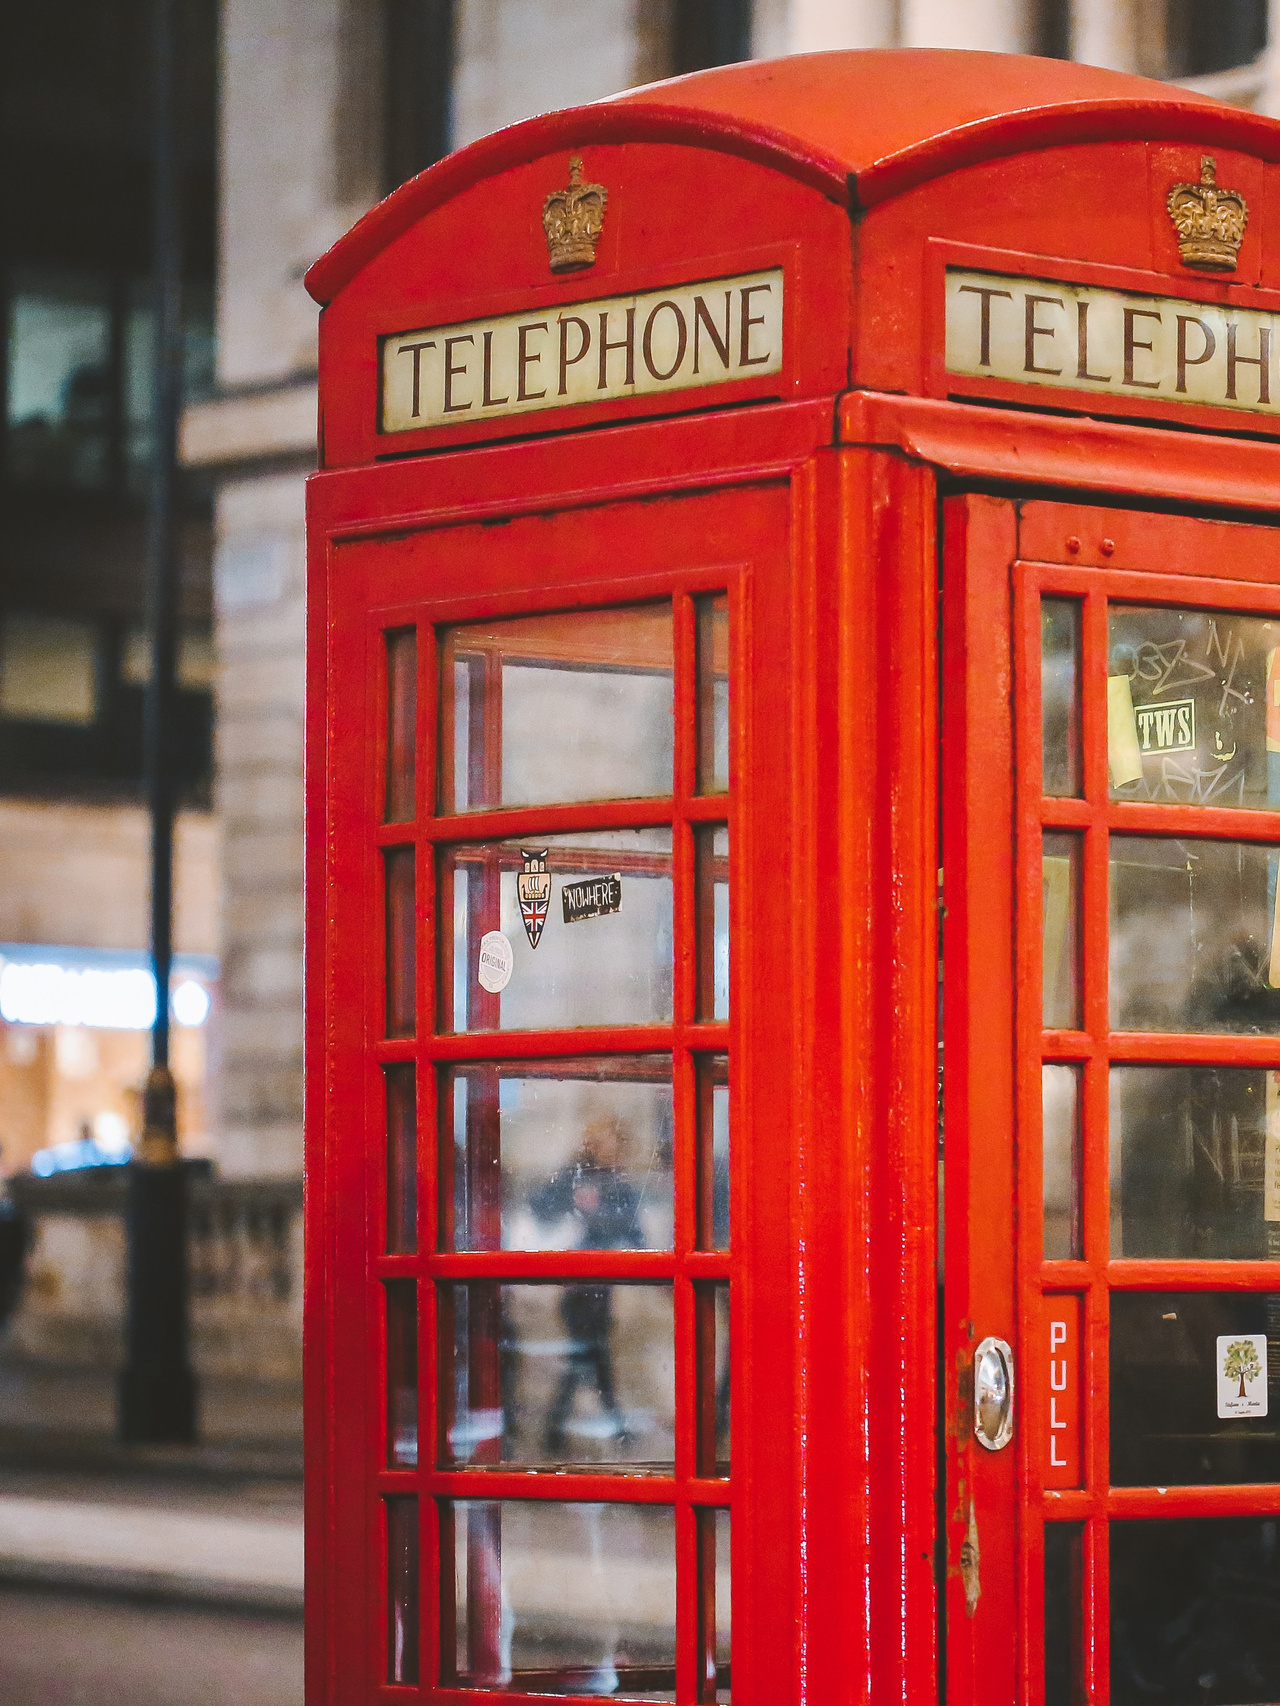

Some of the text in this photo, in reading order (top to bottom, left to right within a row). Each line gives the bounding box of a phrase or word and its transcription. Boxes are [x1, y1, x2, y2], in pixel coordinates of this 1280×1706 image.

[397, 284, 772, 418] TELEPHONE
[1138, 706, 1192, 750] TWS
[568, 882, 615, 910] NOWHERE
[481, 952, 507, 972] ORIGINAL
[1050, 1321, 1067, 1467] PULL
